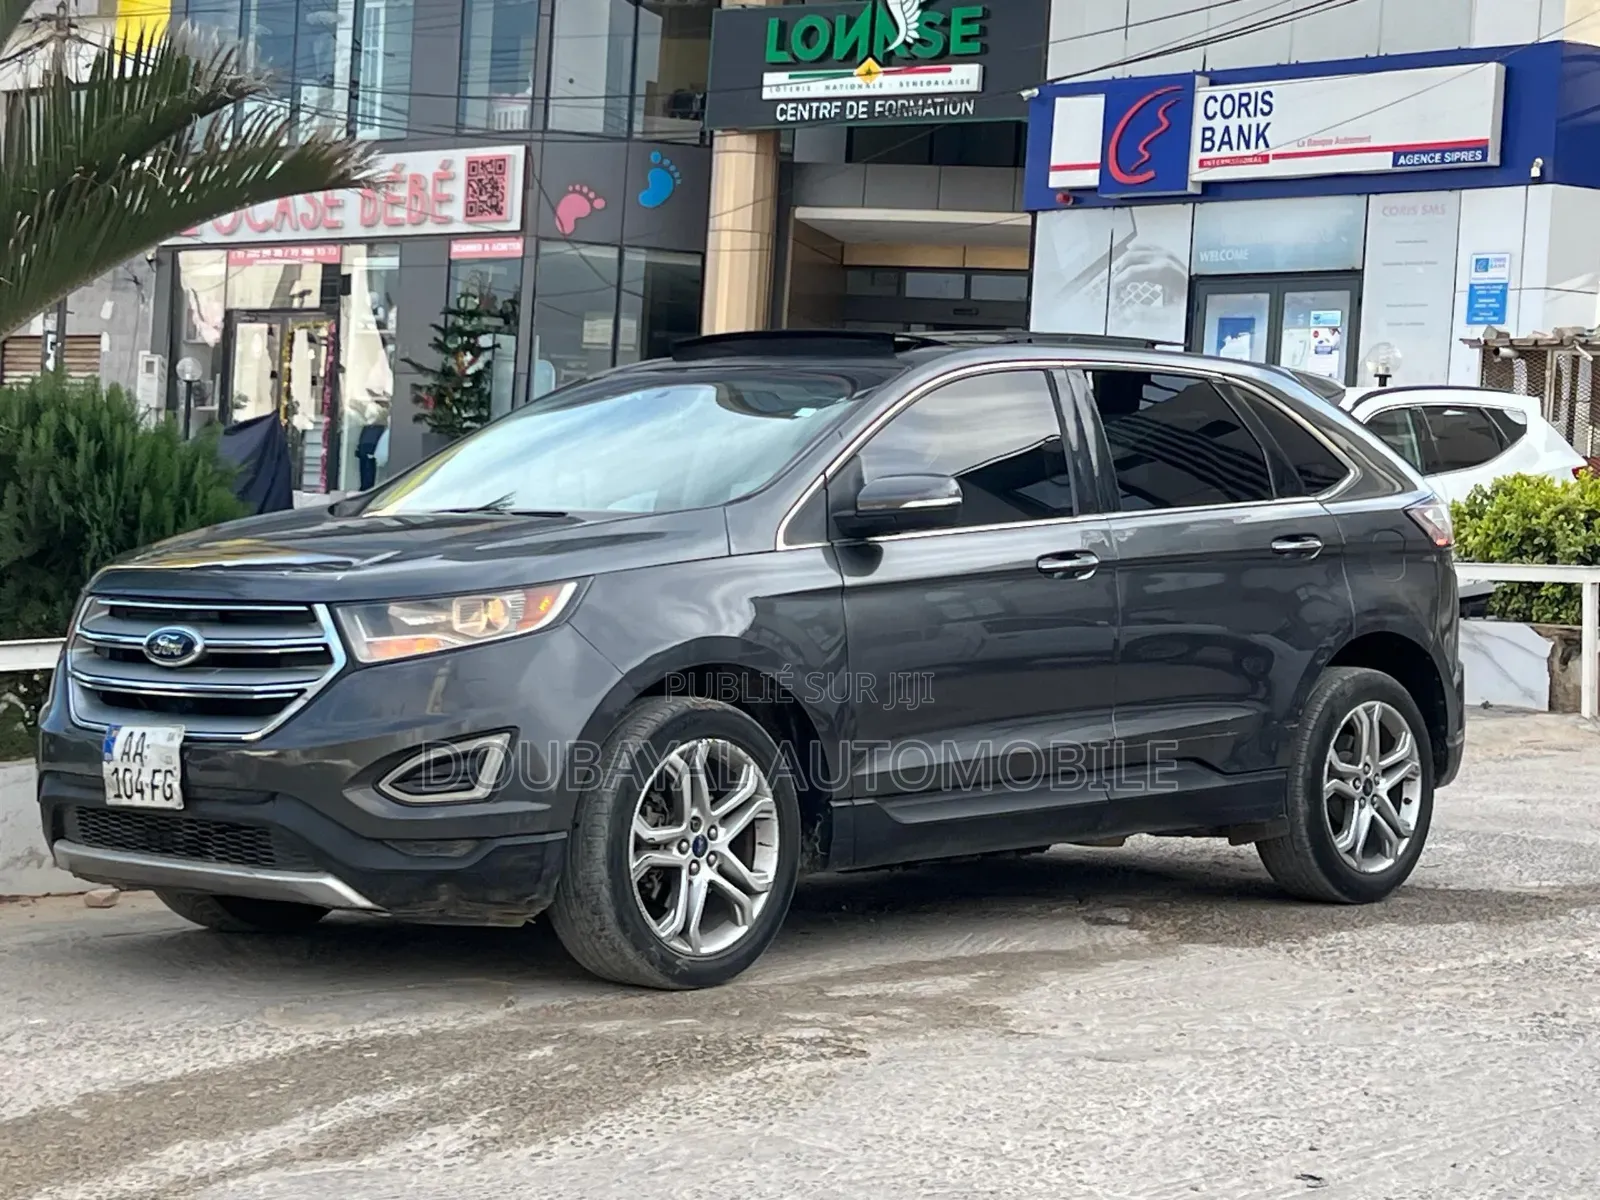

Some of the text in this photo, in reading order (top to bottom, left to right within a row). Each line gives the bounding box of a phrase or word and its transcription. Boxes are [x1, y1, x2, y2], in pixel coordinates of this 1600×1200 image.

[765, 0, 984, 63] LONASE
[824, 82, 884, 91] NATIONALE
[776, 99, 975, 121] CENTRE DE FORMATION
[1203, 90, 1274, 121] CORIS
[1200, 122, 1271, 153] BANK
[1398, 150, 1482, 165] AGENCE SIPRES
[1421, 204, 1446, 216] SMS
[1200, 249, 1249, 262] WELCOME
